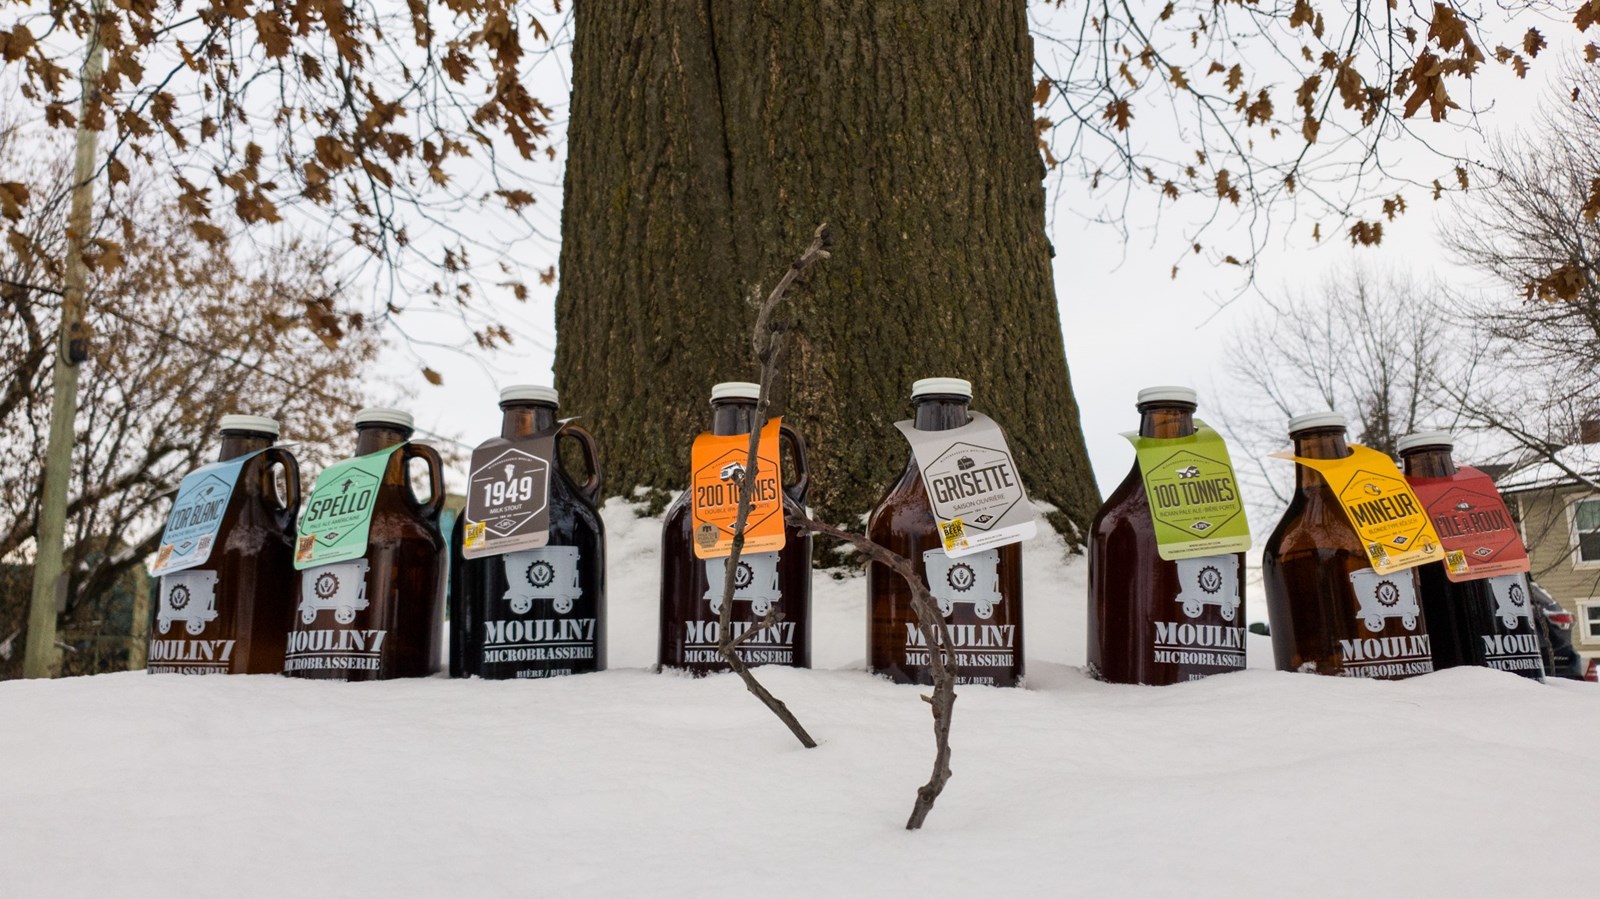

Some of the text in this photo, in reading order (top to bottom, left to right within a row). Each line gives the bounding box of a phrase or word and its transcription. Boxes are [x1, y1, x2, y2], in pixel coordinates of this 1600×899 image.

[484, 476, 533, 507] 1949
[697, 478, 777, 508] 200 TONES
[932, 463, 1014, 504] GRISETTE
[1153, 477, 1235, 509] 100 TONNES
[189, 498, 225, 527] BLANC
[307, 489, 372, 522] SPELLO
[489, 503, 523, 514] MILK STOUT
[952, 502, 976, 512] SAISON
[1349, 492, 1419, 528] MINEUR
[1470, 509, 1510, 533] ROUX
[285, 629, 388, 654] MOULIN7
[484, 618, 596, 644] MOULIN7
[484, 646, 594, 663] MICROBRASSERIE
[684, 650, 793, 663] MICRORASSERIE
[516, 668, 544, 678] BIÈRE
